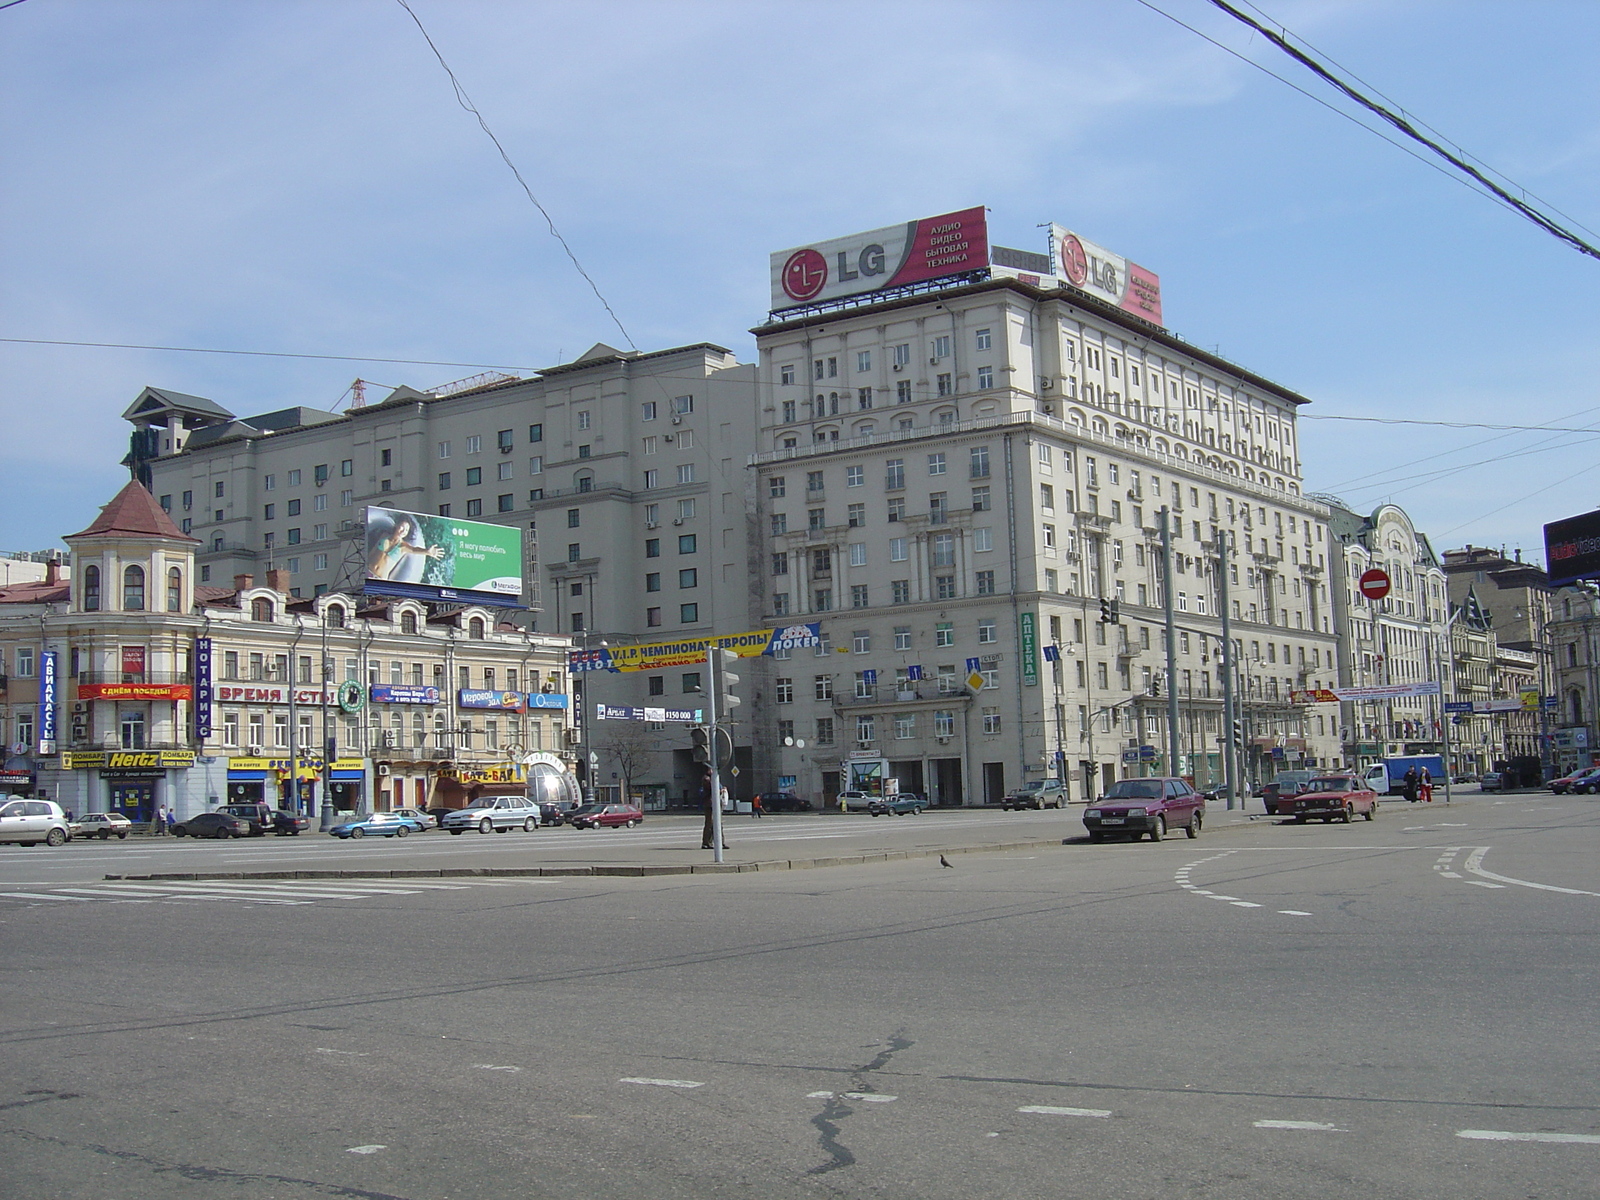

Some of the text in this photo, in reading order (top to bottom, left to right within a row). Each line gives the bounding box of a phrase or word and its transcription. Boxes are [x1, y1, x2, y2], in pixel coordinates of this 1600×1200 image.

[931, 221, 961, 235] АУДИО
[930, 232, 962, 246] ВИДЕО
[925, 241, 969, 258] БЫТОВАЯ
[838, 243, 886, 283] LG
[926, 253, 968, 268] ТЕХНИКА
[1091, 256, 1118, 296] LG
[459, 540, 464, 549] Я
[612, 632, 772, 660] V.I.P. ЧЕМПИОНАТ "ЕВРОПЫ"
[772, 636, 819, 651] ПОКЕР
[1023, 614, 1034, 674] АПТЕКА
[577, 660, 613, 672] SLOT
[199, 641, 208, 736] НОТАРИУС
[219, 686, 281, 702] ВРЕМЯ
[44, 657, 54, 739] АВИАКАССЫ
[680, 711, 691, 719] 000
[110, 752, 160, 767] Hertz
[162, 751, 193, 759] ЛОМБАРД
[463, 768, 513, 782] КАФЕ-БАР
